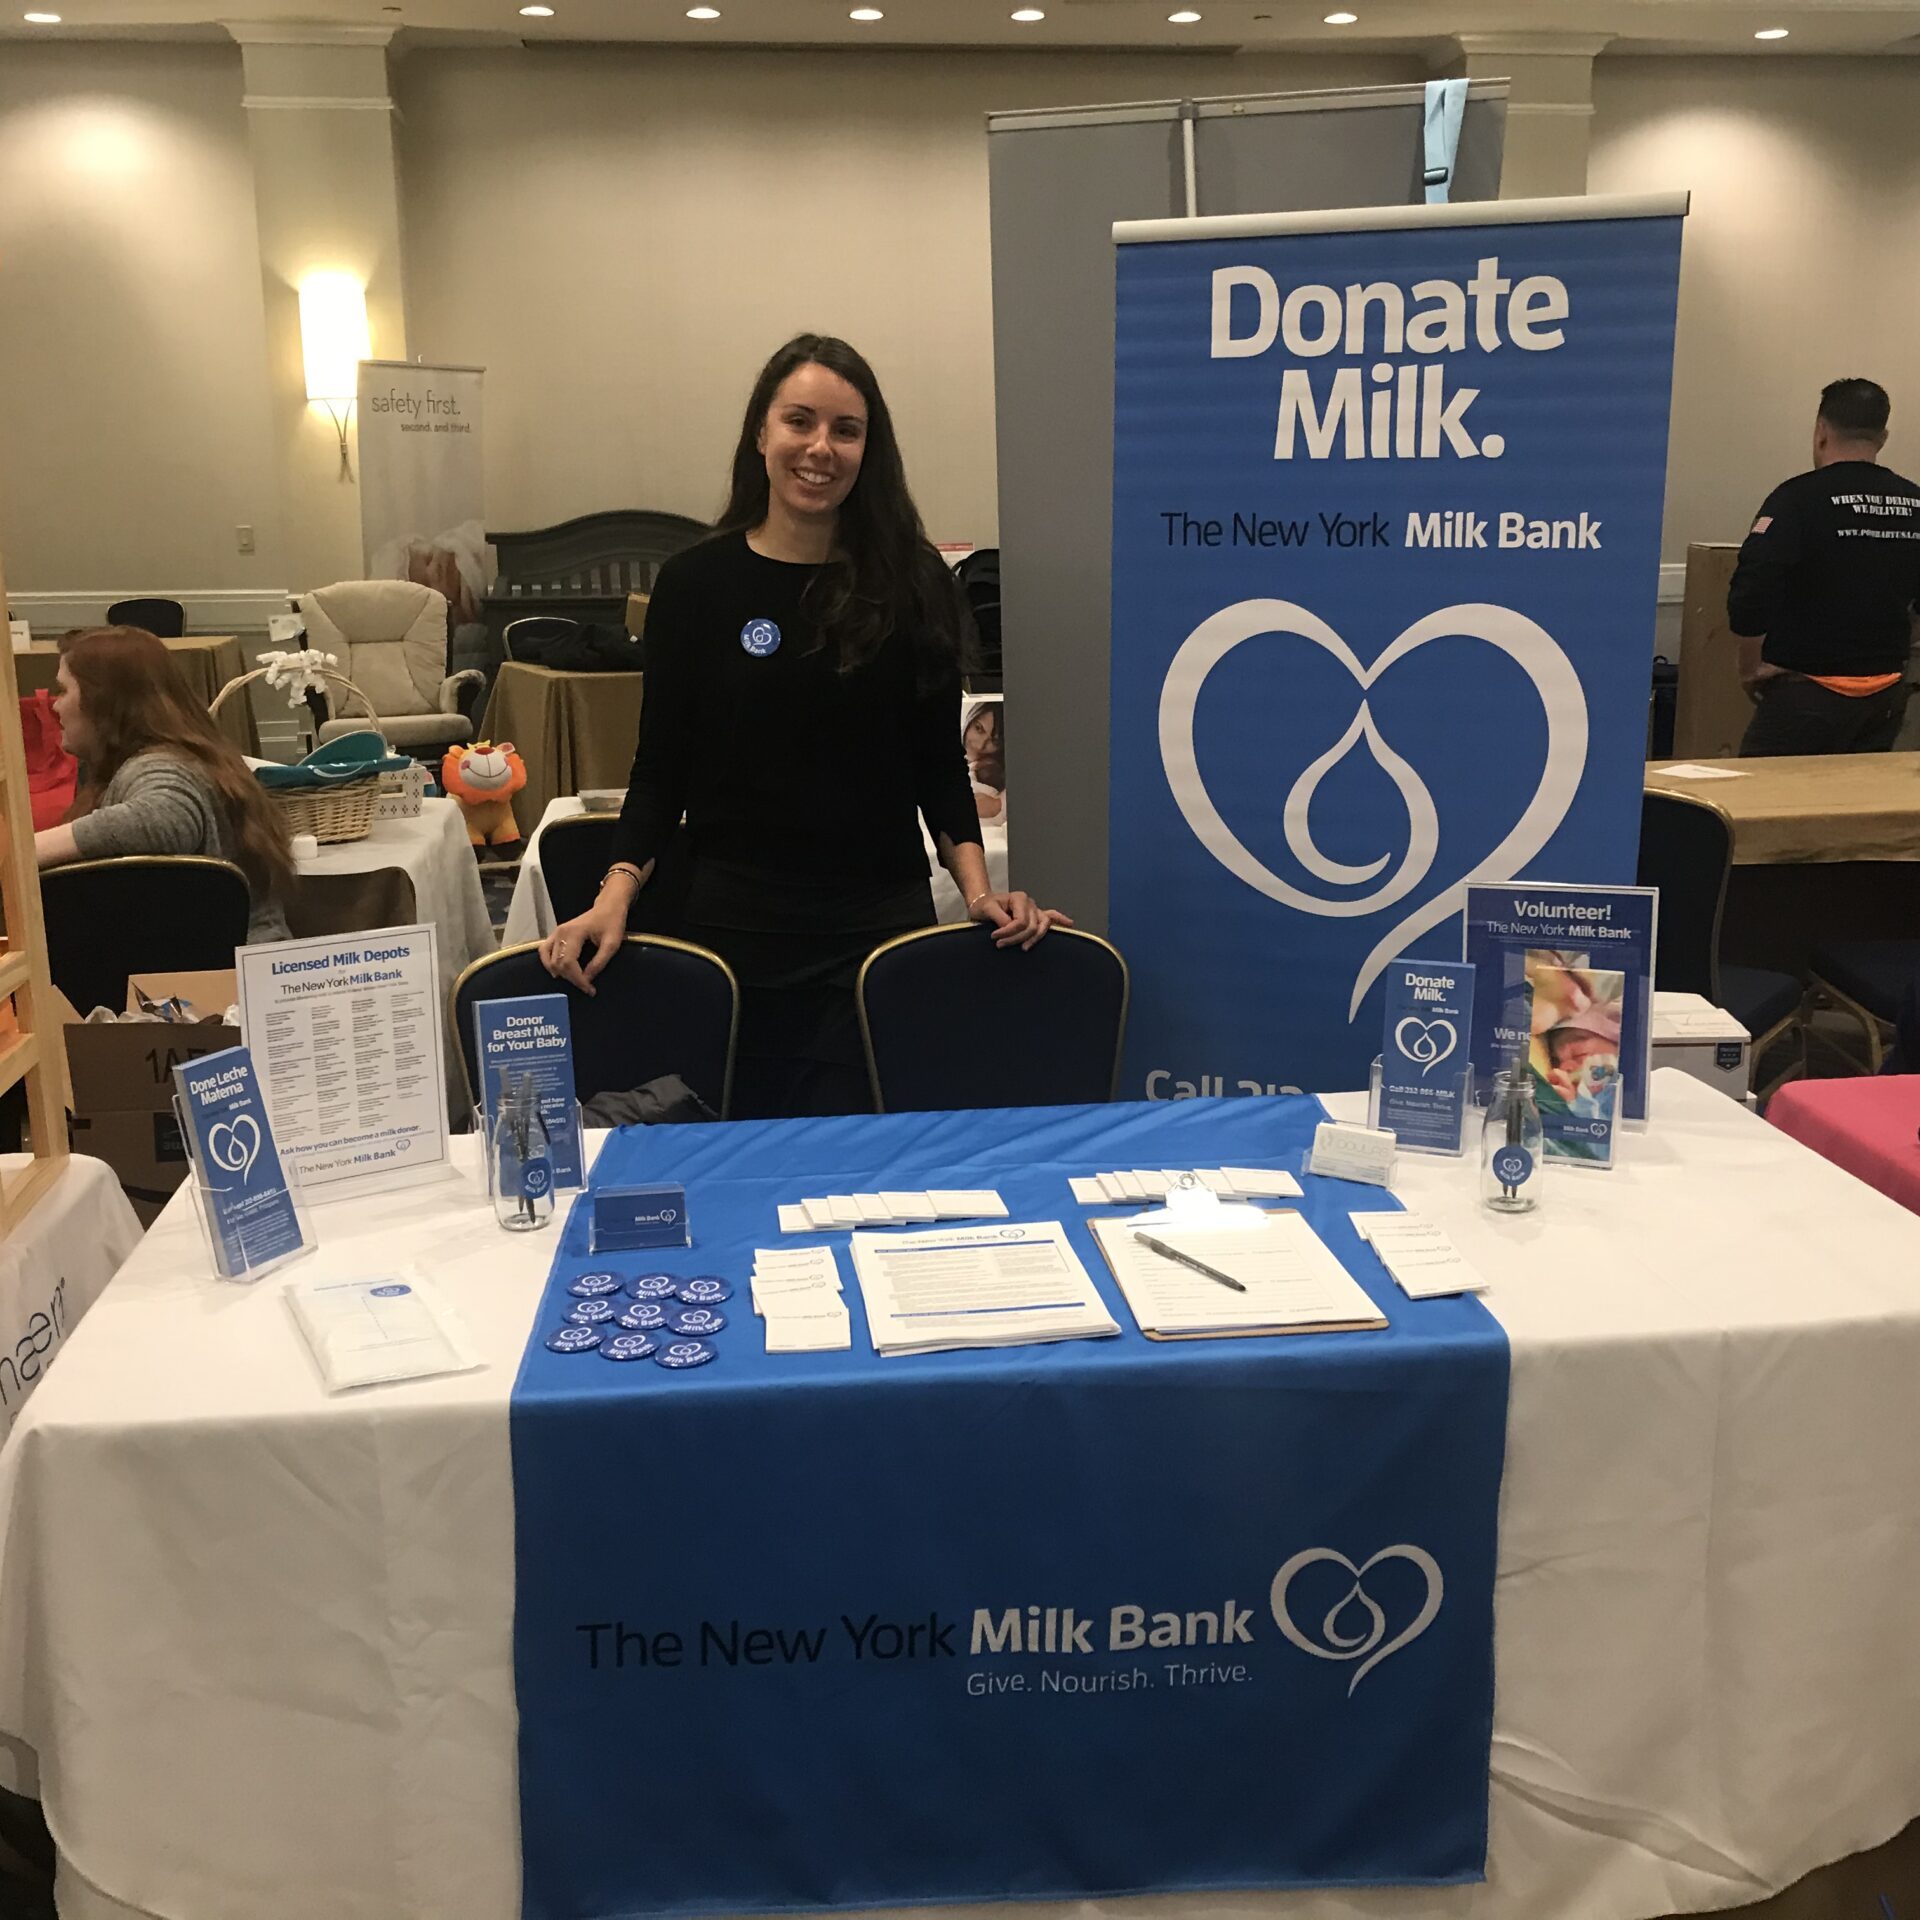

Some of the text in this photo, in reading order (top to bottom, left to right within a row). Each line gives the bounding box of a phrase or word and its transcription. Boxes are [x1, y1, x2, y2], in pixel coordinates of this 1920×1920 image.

[1210, 256, 1570, 359] Donate
[371, 388, 461, 419] safety first.
[1273, 362, 1506, 460] Milk.
[1831, 494, 1863, 504] WHEN
[1865, 494, 1884, 504] YOU
[1853, 504, 1912, 516] WE DELIVER!
[1160, 511, 1603, 550] The New York Milk Bank
[1513, 900, 1612, 921] Volunteer!
[1487, 921, 1631, 940] The New York Milk Bank
[272, 956, 330, 975] Licensed
[333, 951, 361, 967] Milk
[364, 946, 410, 963] Depots
[280, 983, 301, 995] The
[302, 979, 326, 993] New
[326, 977, 349, 990] York
[349, 973, 374, 986] Milk
[374, 969, 403, 982] Bank
[1405, 973, 1455, 989] Donate
[1413, 987, 1446, 1002] Milk.
[492, 1024, 560, 1041] Breast Milk
[506, 1015, 544, 1027] Donor
[1494, 1027, 1515, 1040] We
[487, 1036, 567, 1053] for Your Baby
[190, 1065, 248, 1095] Done Leche
[200, 1082, 245, 1106] Materna
[280, 1146, 295, 1156] Ask
[295, 1144, 313, 1154] how
[314, 1142, 329, 1153] you
[329, 1139, 343, 1148] can
[344, 1133, 374, 1145] become
[380, 1128, 396, 1138] milk
[299, 1164, 315, 1175] The
[315, 1160, 334, 1172] New
[334, 1157, 352, 1169] York
[353, 1153, 373, 1165] Milk
[373, 1149, 396, 1161] Bank
[577, 1599, 1255, 1669] The New York Milk Bank
[967, 1662, 1254, 1696] Give. Nourish. Thrive.
